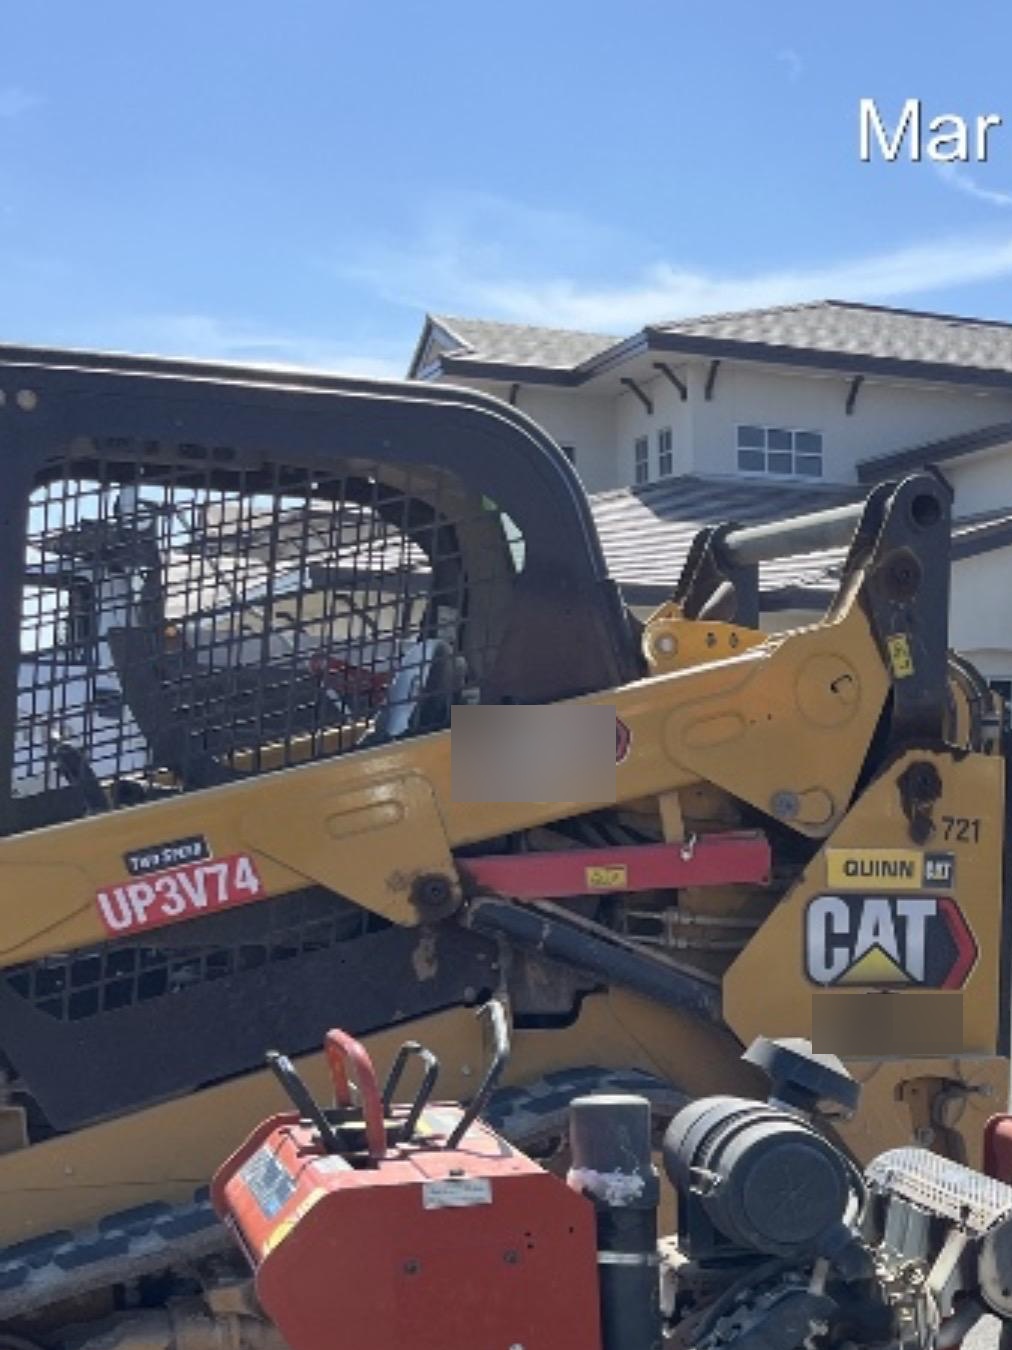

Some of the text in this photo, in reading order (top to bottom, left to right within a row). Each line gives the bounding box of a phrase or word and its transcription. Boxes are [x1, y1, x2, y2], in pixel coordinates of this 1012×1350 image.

[942, 815, 981, 844] 721
[98, 856, 259, 930] UP3V74
[843, 860, 916, 877] QUINN
[805, 896, 938, 988] CAT
